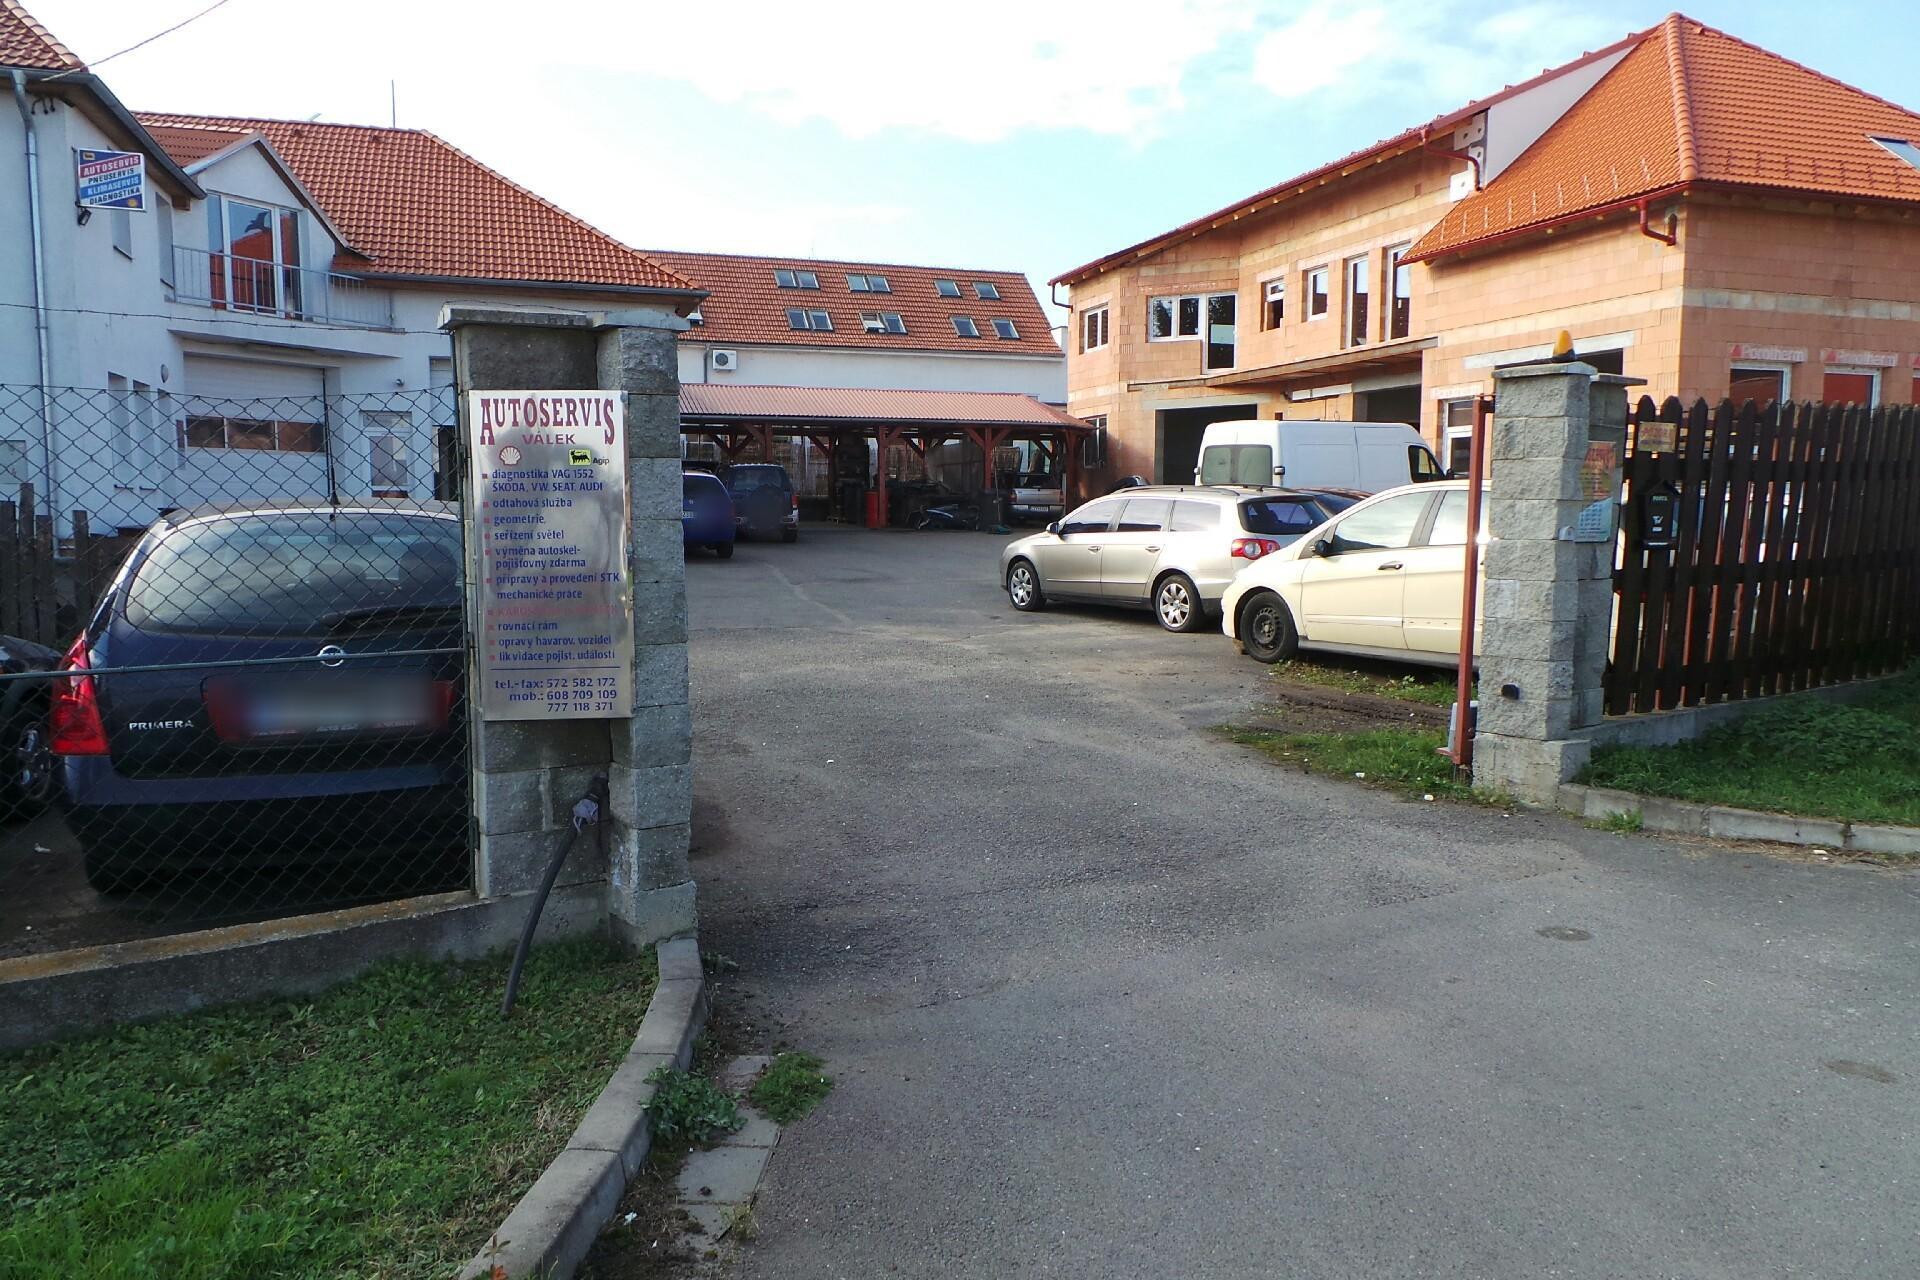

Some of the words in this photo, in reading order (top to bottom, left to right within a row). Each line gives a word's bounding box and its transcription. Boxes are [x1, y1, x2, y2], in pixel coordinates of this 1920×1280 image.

[83, 156, 139, 176] AUTOSERVIS
[88, 167, 134, 184] PNEUSERVIS
[87, 176, 139, 195] KLIMASERVIS
[89, 187, 140, 205] DIAGNOSTIKA
[480, 397, 615, 446] AUTOSERVIS
[522, 431, 576, 445] VÁLEK
[592, 457, 609, 466] Agip
[492, 469, 548, 481] diagnostika
[552, 469, 570, 478] VAG
[574, 469, 594, 478] 1552
[580, 482, 603, 491] AUDI
[493, 498, 539, 508] odtahová
[541, 497, 572, 507] služba
[494, 530, 534, 540] seřízení
[536, 530, 564, 540] světel
[496, 545, 535, 558] výměna
[496, 559, 546, 571] pojišťovny
[550, 558, 586, 568] zdarma
[496, 574, 538, 586] přípravy
[549, 573, 597, 585] provedení
[600, 572, 620, 582] STK
[497, 589, 554, 600] mechanické
[556, 589, 583, 601] práce
[498, 621, 535, 631] rovnací
[538, 620, 558, 631] rám
[499, 638, 534, 649] opravy
[536, 636, 575, 646] havarov.
[578, 635, 612, 645] vozidel
[499, 651, 544, 661] likvidace
[546, 650, 576, 662] pojist.
[547, 679, 568, 688] 572
[573, 678, 593, 687] 582
[598, 677, 616, 686] 172
[547, 691, 569, 700] 608
[573, 690, 593, 699] 709
[598, 690, 617, 699] 109
[547, 703, 569, 712] 777
[574, 702, 590, 711] 118
[595, 702, 613, 711] 371
[129, 719, 194, 731] PRIMERA
